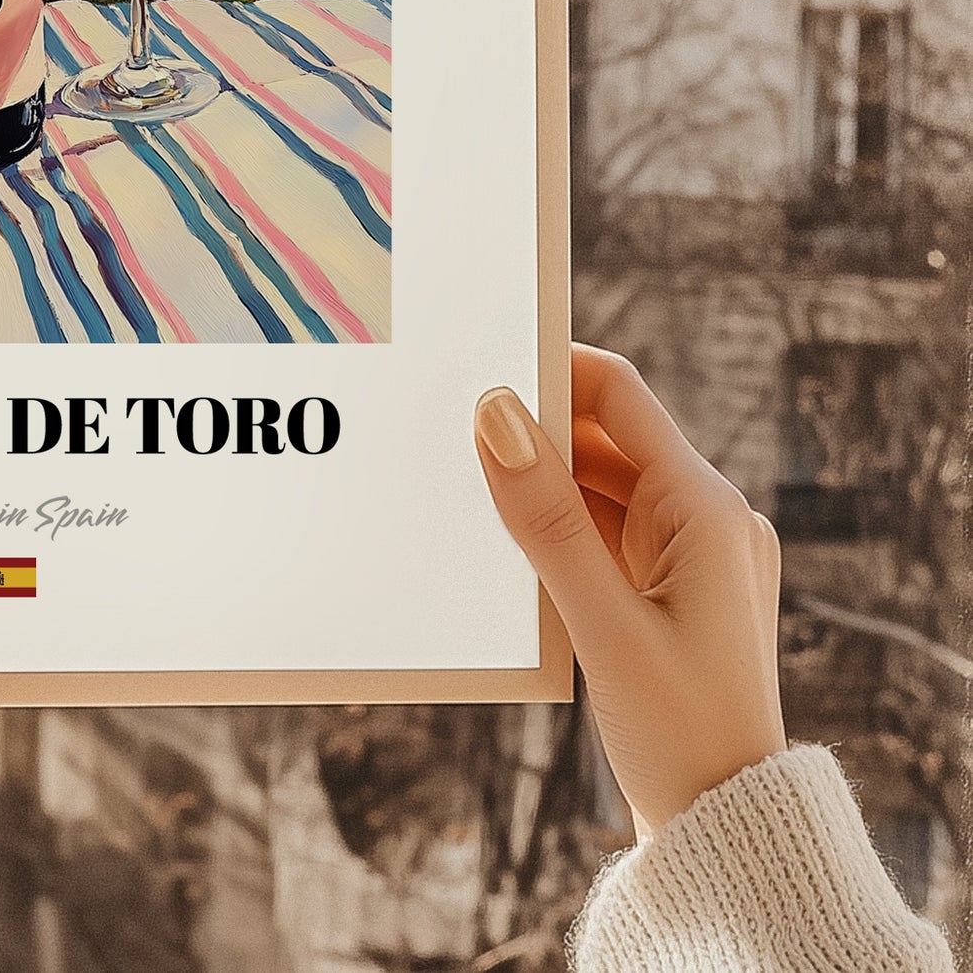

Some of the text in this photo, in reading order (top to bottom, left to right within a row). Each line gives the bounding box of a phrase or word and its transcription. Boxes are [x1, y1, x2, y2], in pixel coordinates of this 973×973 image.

[7, 397, 109, 455] DE
[127, 397, 341, 455] TORO
[33, 496, 129, 541] Spain
